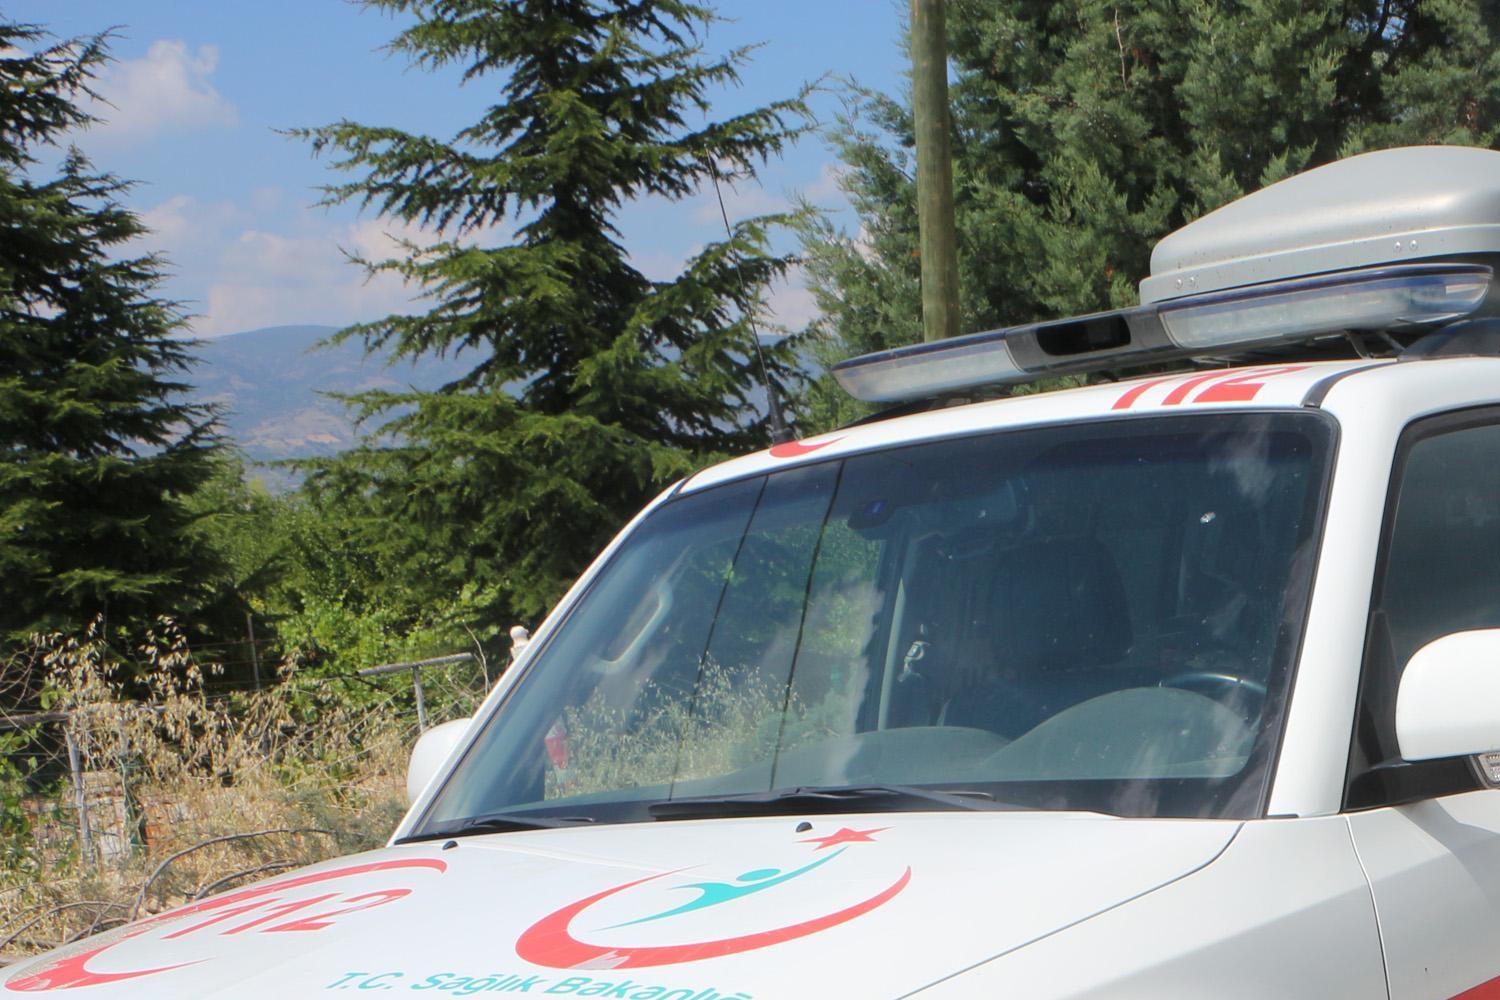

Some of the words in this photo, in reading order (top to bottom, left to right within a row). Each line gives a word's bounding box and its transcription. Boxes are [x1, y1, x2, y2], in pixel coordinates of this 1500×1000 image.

[1111, 365, 1313, 410] 112
[159, 888, 413, 940] 112
[325, 972, 404, 990] T.C.
[410, 972, 549, 996] Sağlık
